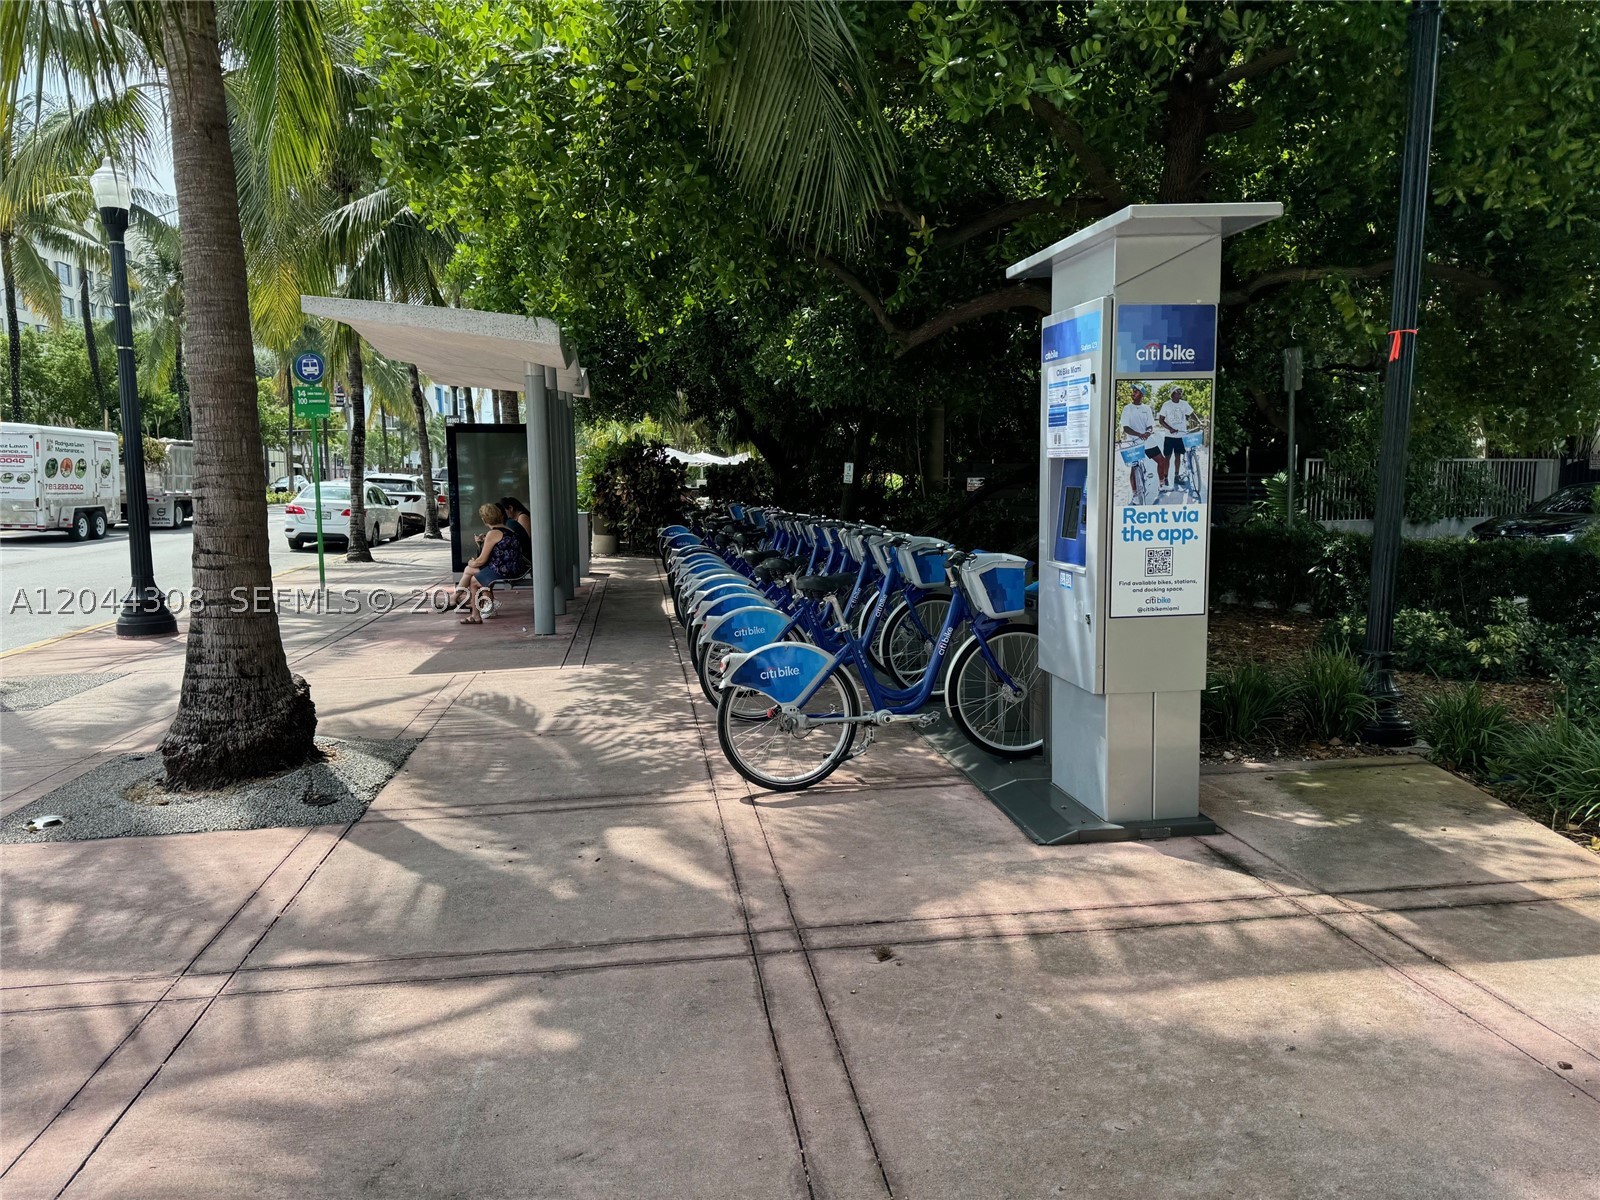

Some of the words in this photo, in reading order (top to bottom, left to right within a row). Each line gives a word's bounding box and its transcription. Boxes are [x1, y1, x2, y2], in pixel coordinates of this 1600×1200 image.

[1136, 343, 1160, 361] citi
[1163, 344, 1195, 361] bike
[297, 397, 308, 405] 100
[1122, 507, 1169, 524] Rent
[1172, 506, 1199, 522] via
[1121, 525, 1154, 542] the
[1157, 527, 1199, 545] app.
[1145, 596, 1156, 604] citi
[1137, 605, 1180, 613] @citibikemiami
[734, 628, 748, 637] citi
[748, 626, 766, 635] bike
[941, 626, 954, 644] bike
[938, 642, 948, 656] citi
[760, 667, 777, 680] citi
[777, 666, 800, 678] bike
